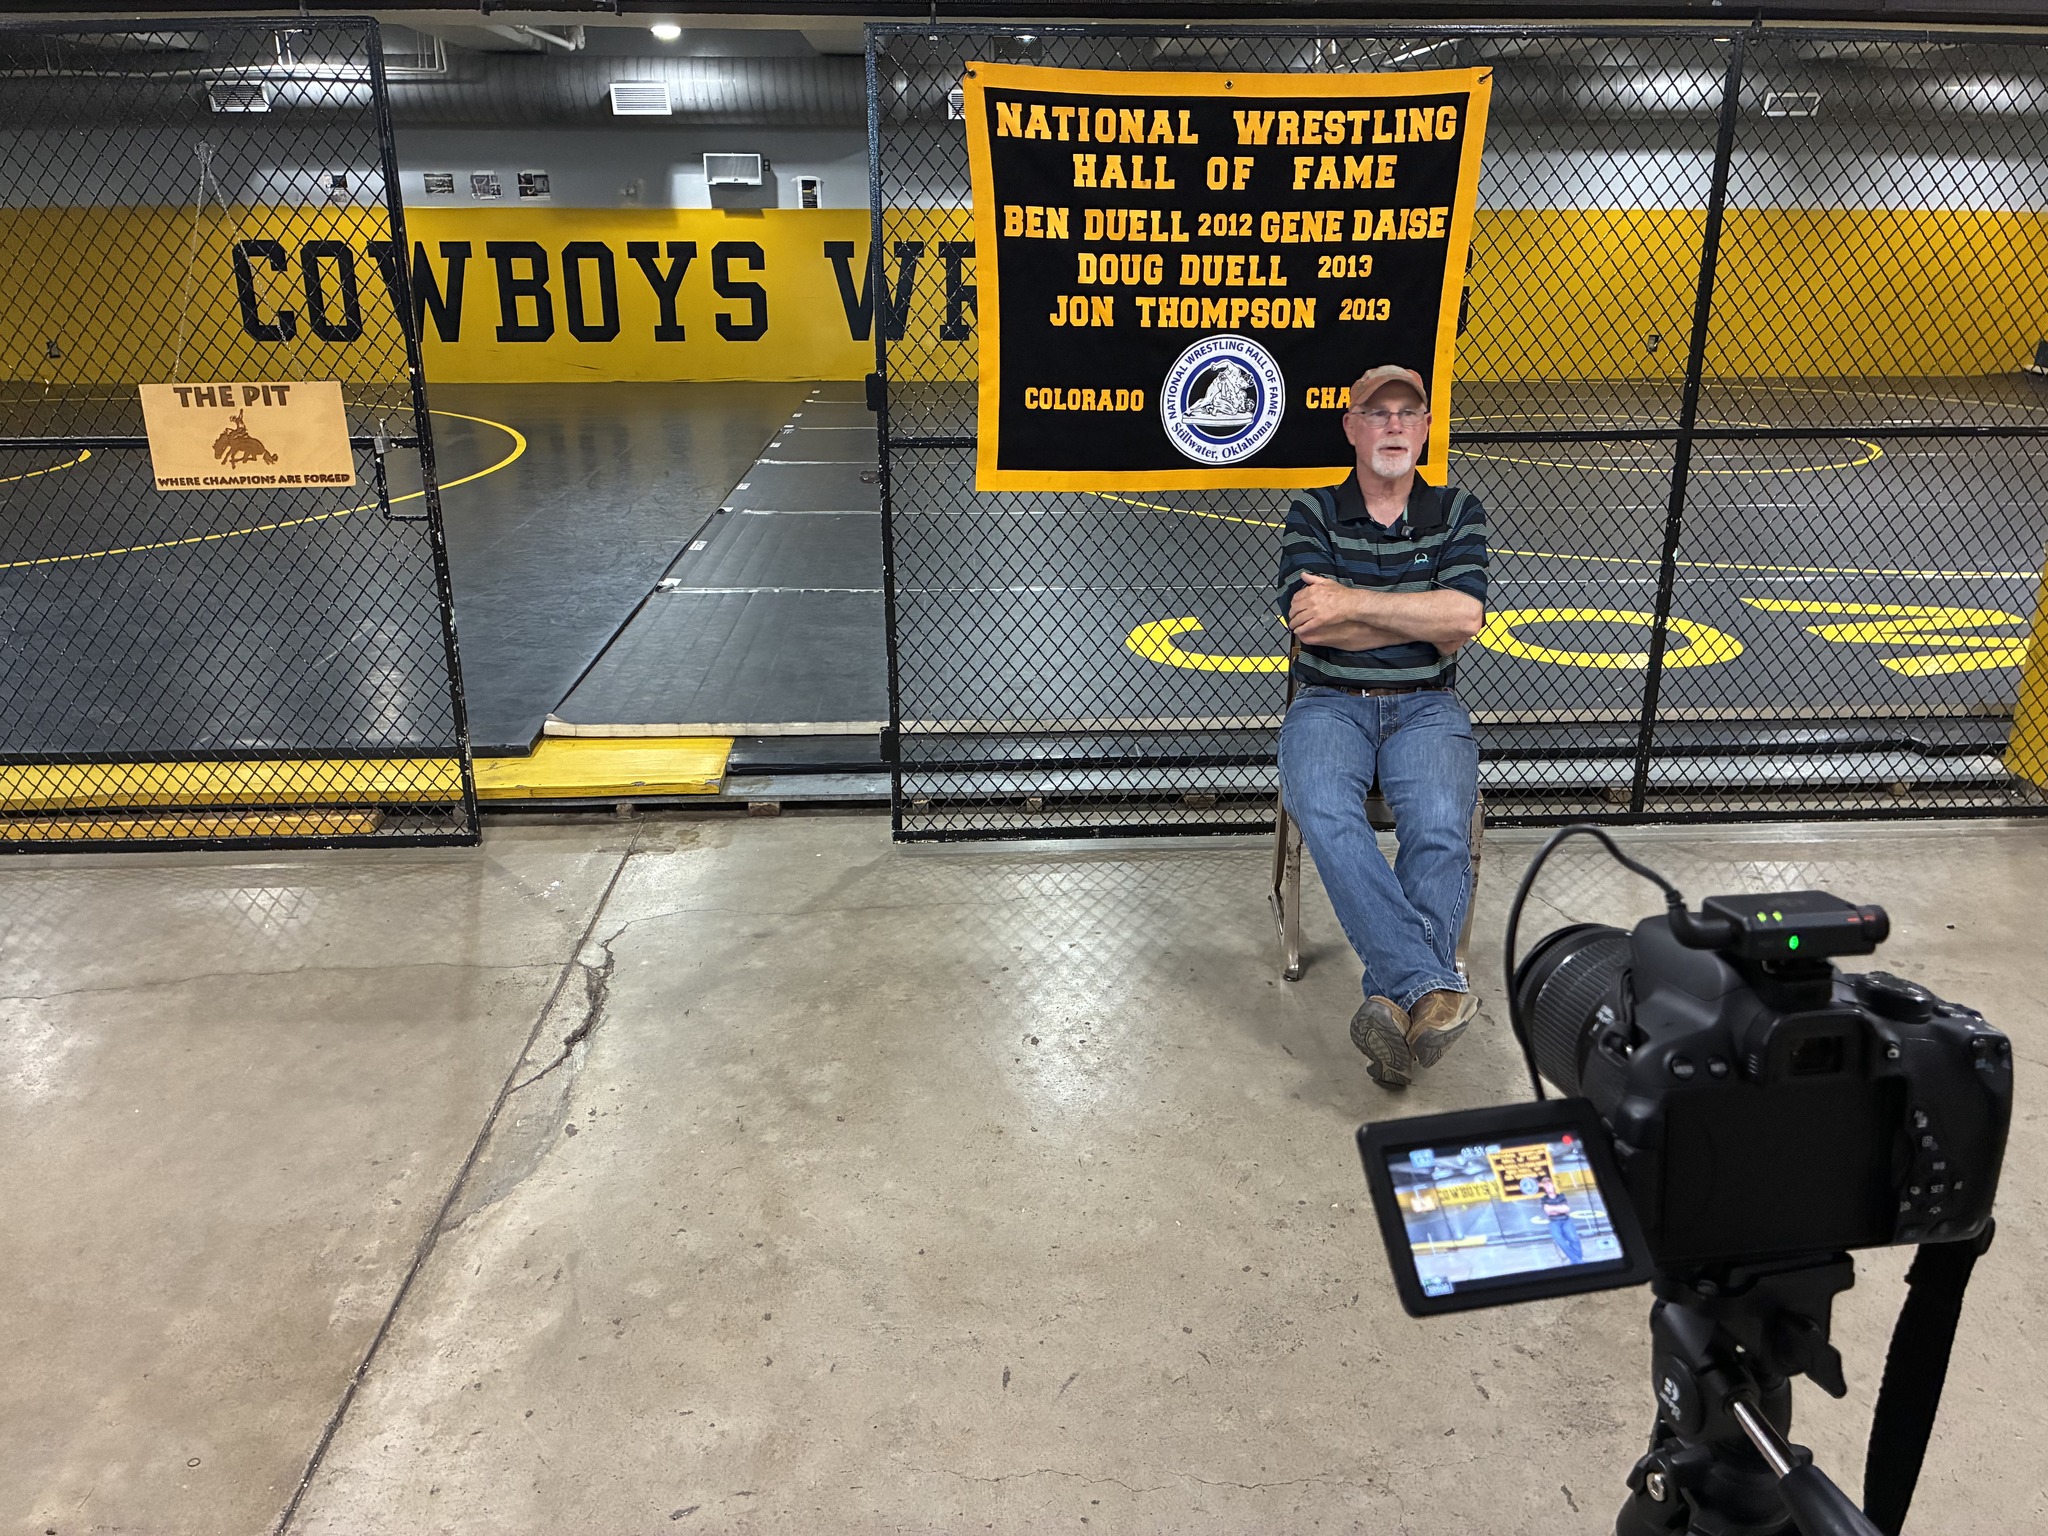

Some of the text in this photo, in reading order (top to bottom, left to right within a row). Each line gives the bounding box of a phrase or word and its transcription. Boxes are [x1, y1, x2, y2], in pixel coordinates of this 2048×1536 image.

[996, 102, 1457, 145] NATIONAL WRESTLING
[1073, 154, 1397, 190] HALL OF FAME
[1004, 205, 1449, 243] BEN DUELL 2012 GENE DAISE
[1078, 253, 1373, 286] DOUG DUELL 2013
[232, 240, 769, 342] COWBOYS
[1050, 296, 1391, 328] JON THOMPSON 2013
[173, 385, 290, 407] THE PIT
[1166, 340, 1279, 420] NATIONAL WRESTLING HALL OF FAME
[1025, 388, 1144, 411] COLORADO
[1171, 421, 1273, 461] Stillwater, Oklahoma
[158, 473, 350, 487] WHERE CHAMPIONS ARE FORGED
